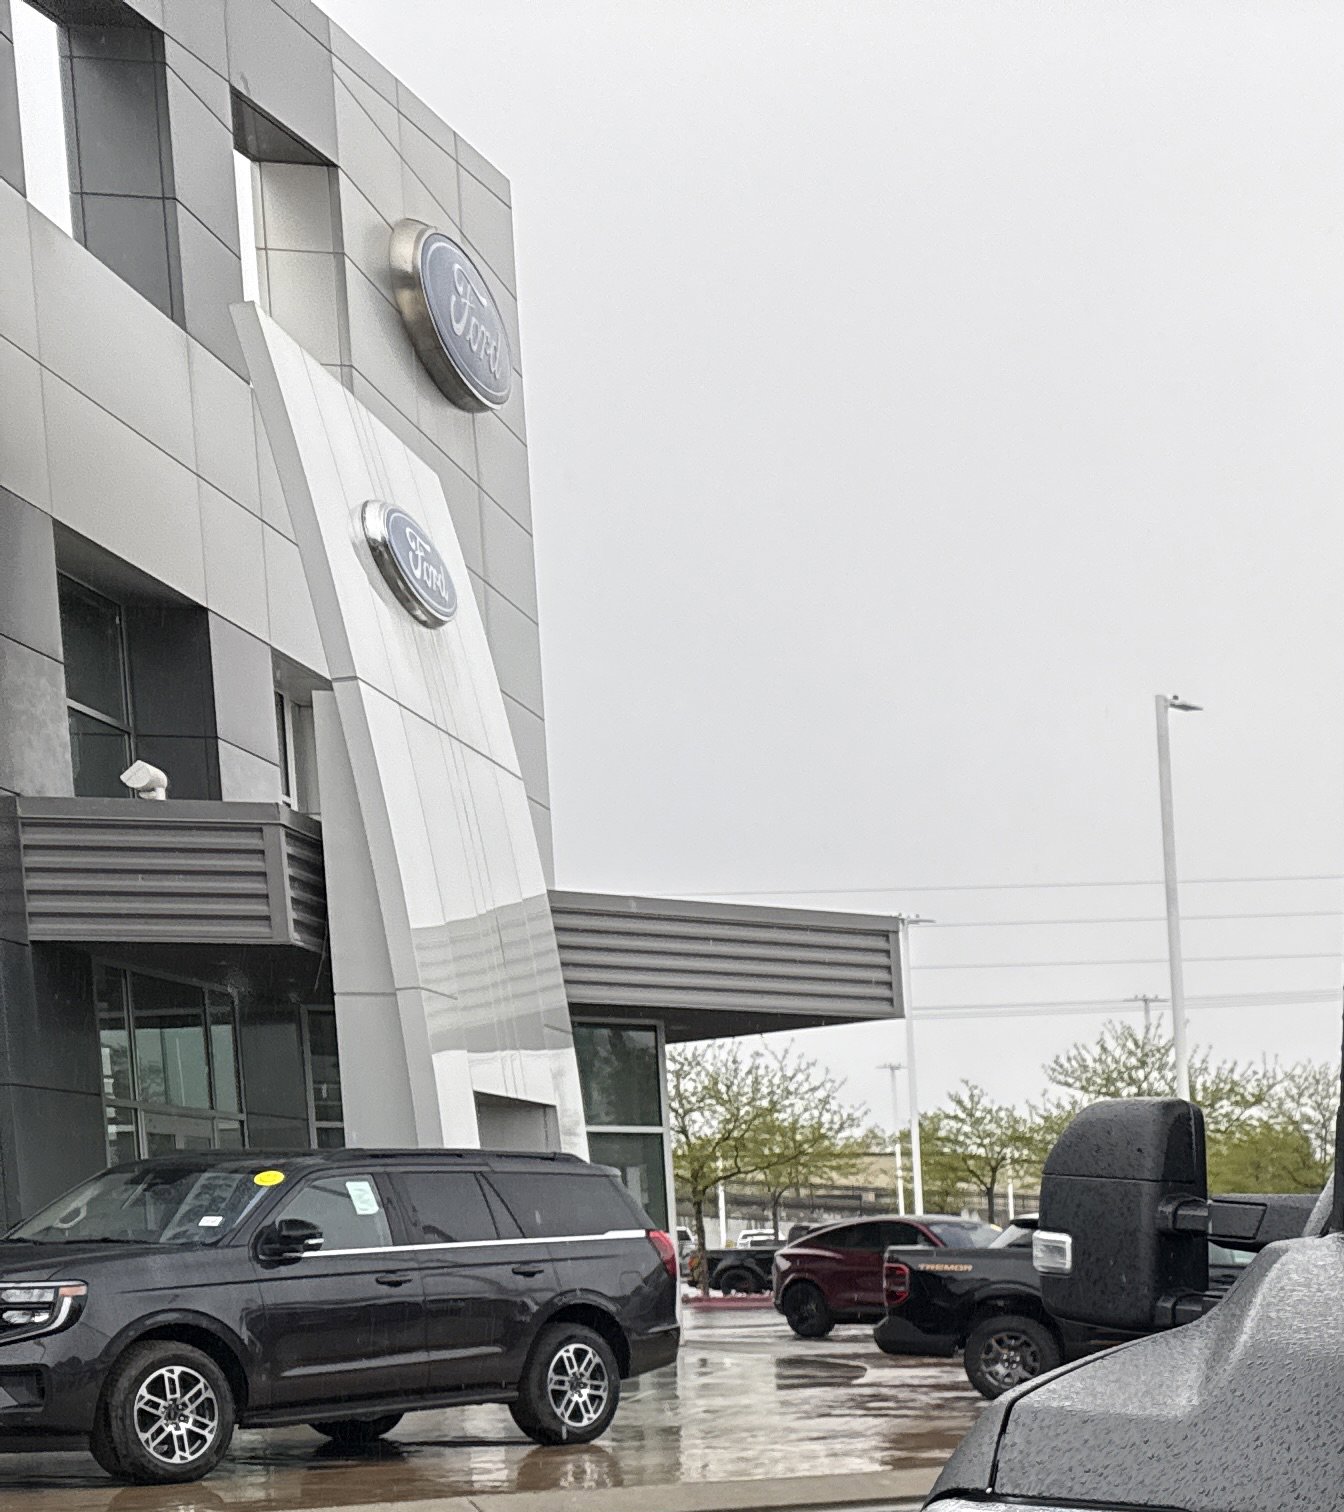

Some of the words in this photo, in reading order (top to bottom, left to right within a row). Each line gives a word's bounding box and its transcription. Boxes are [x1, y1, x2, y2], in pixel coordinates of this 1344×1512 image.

[451, 263, 501, 380] Ford
[405, 527, 449, 603] Ford
[918, 1263, 973, 1272] TREMOR
